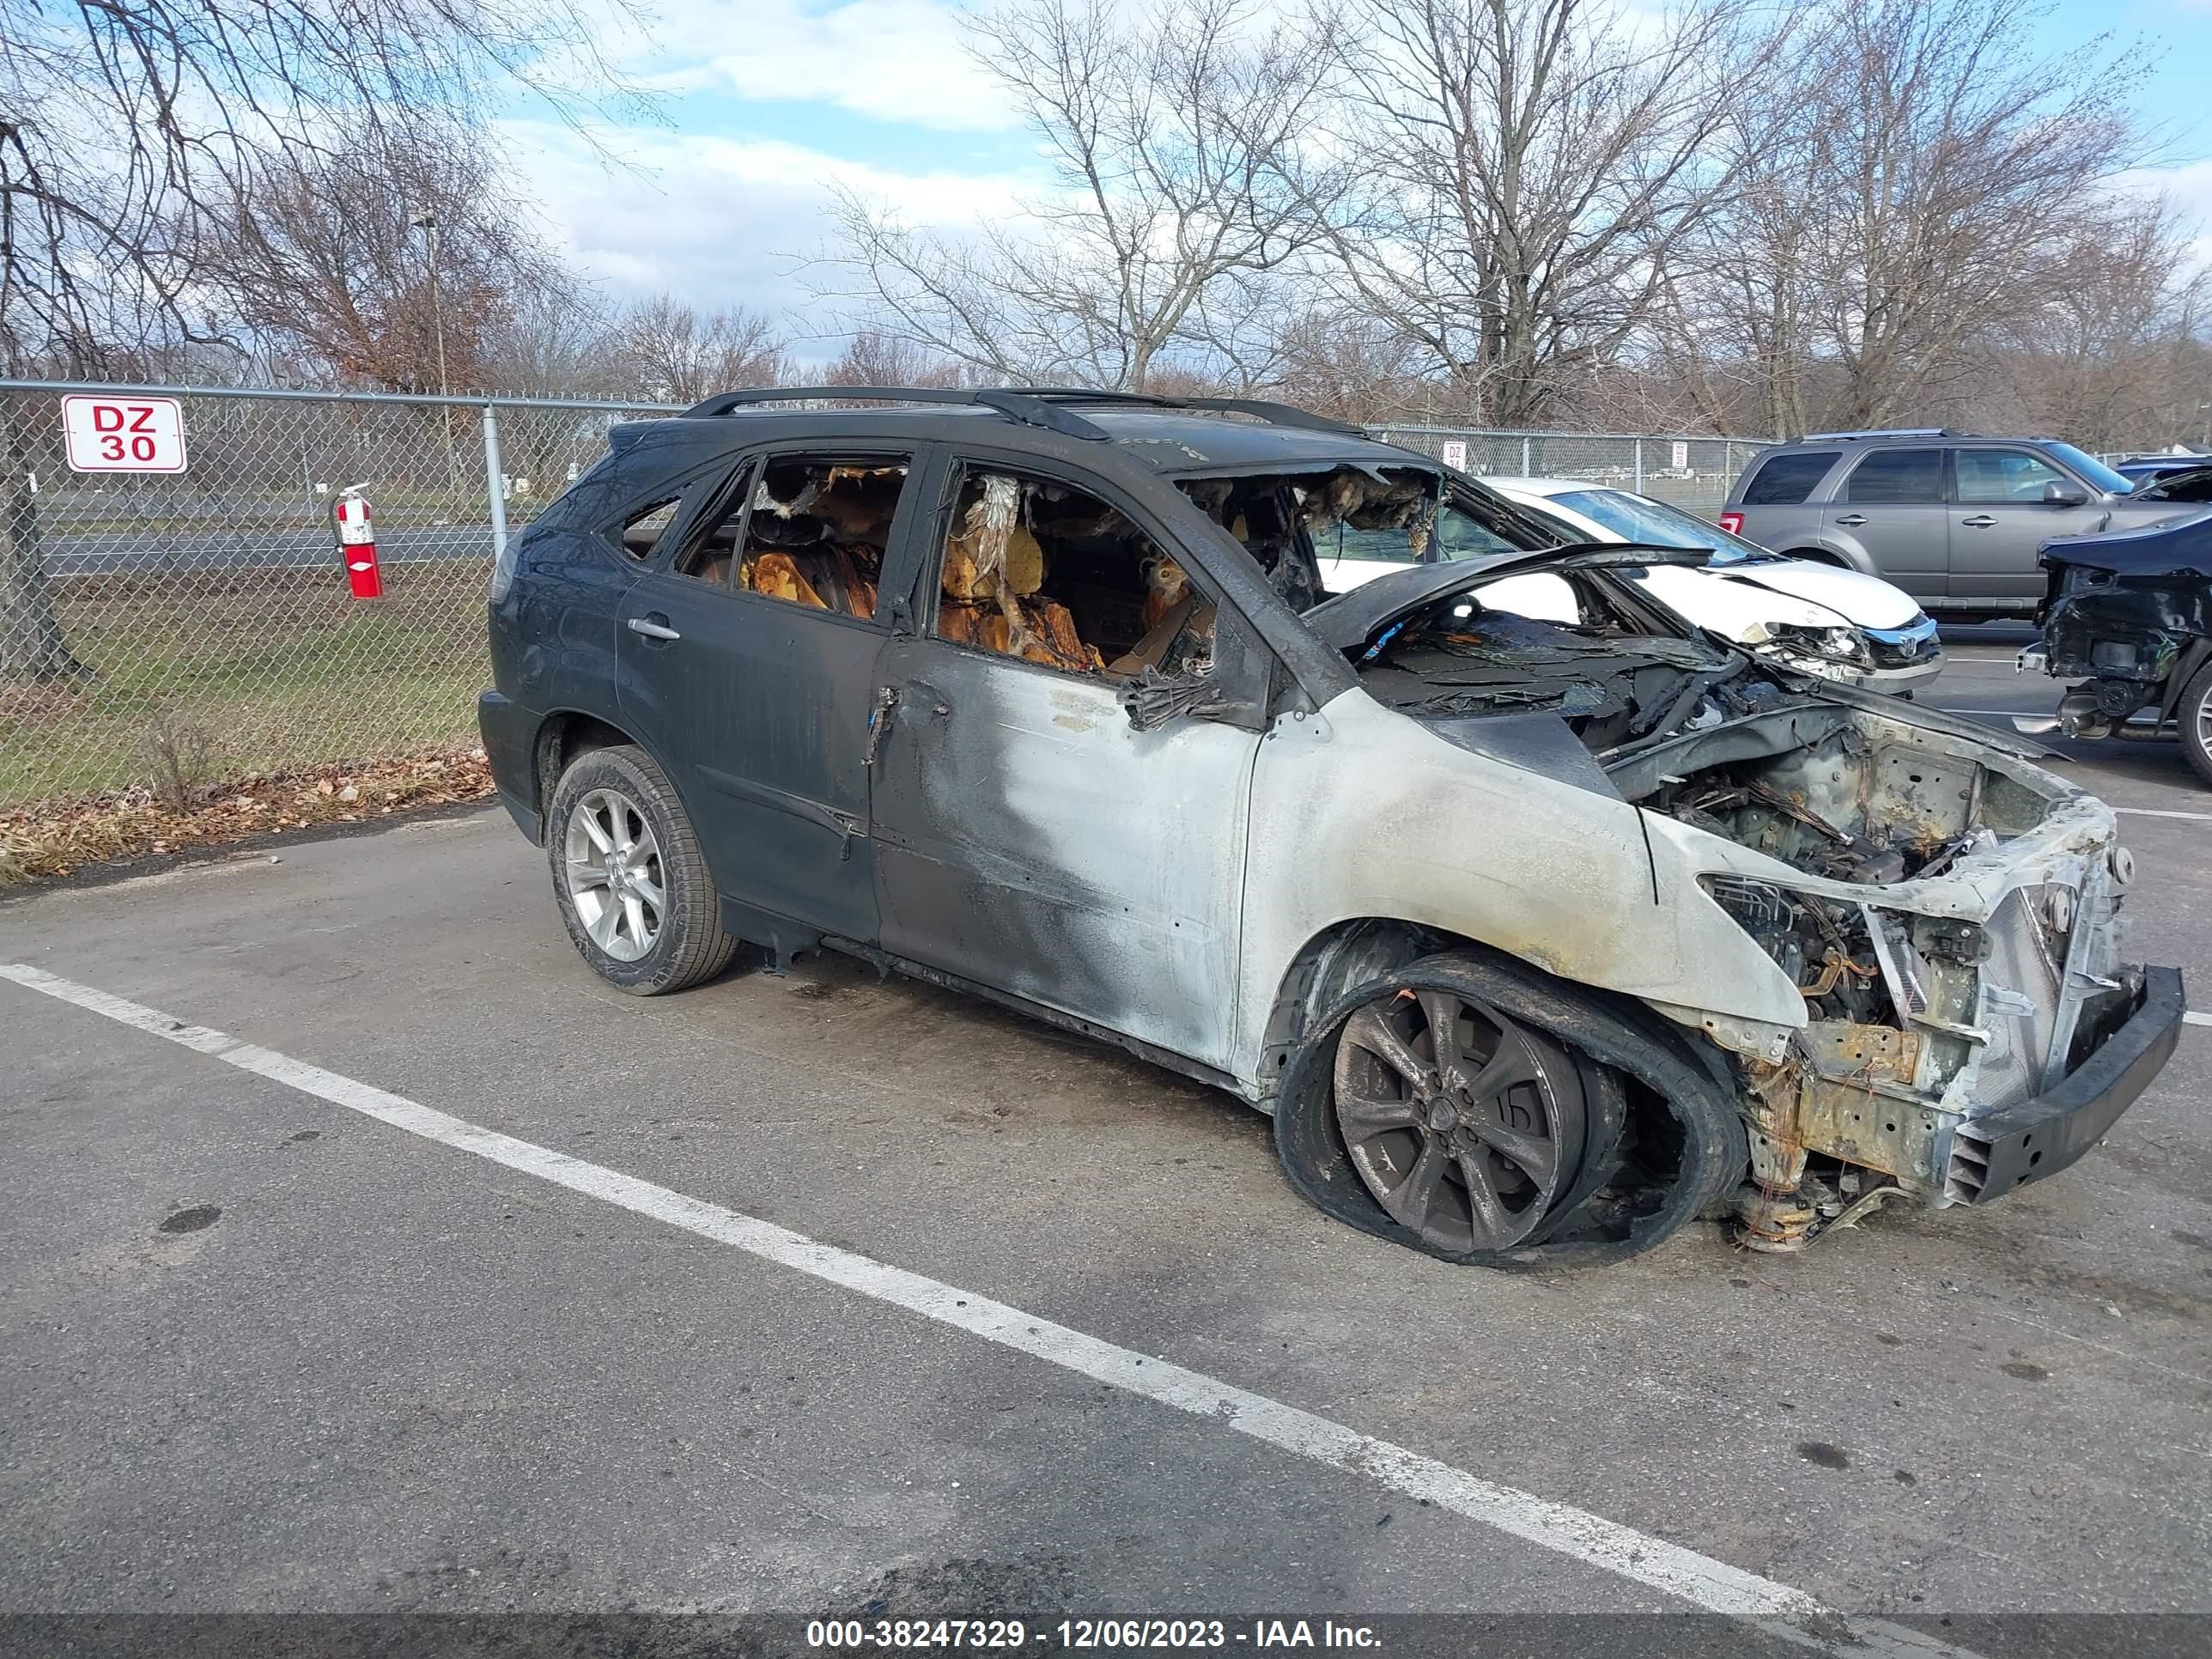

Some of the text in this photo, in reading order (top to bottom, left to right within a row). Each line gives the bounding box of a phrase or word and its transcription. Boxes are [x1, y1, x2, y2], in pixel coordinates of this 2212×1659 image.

[93, 405, 156, 433] DZ
[100, 434, 156, 462] 30
[1449, 446, 1462, 459] DZ
